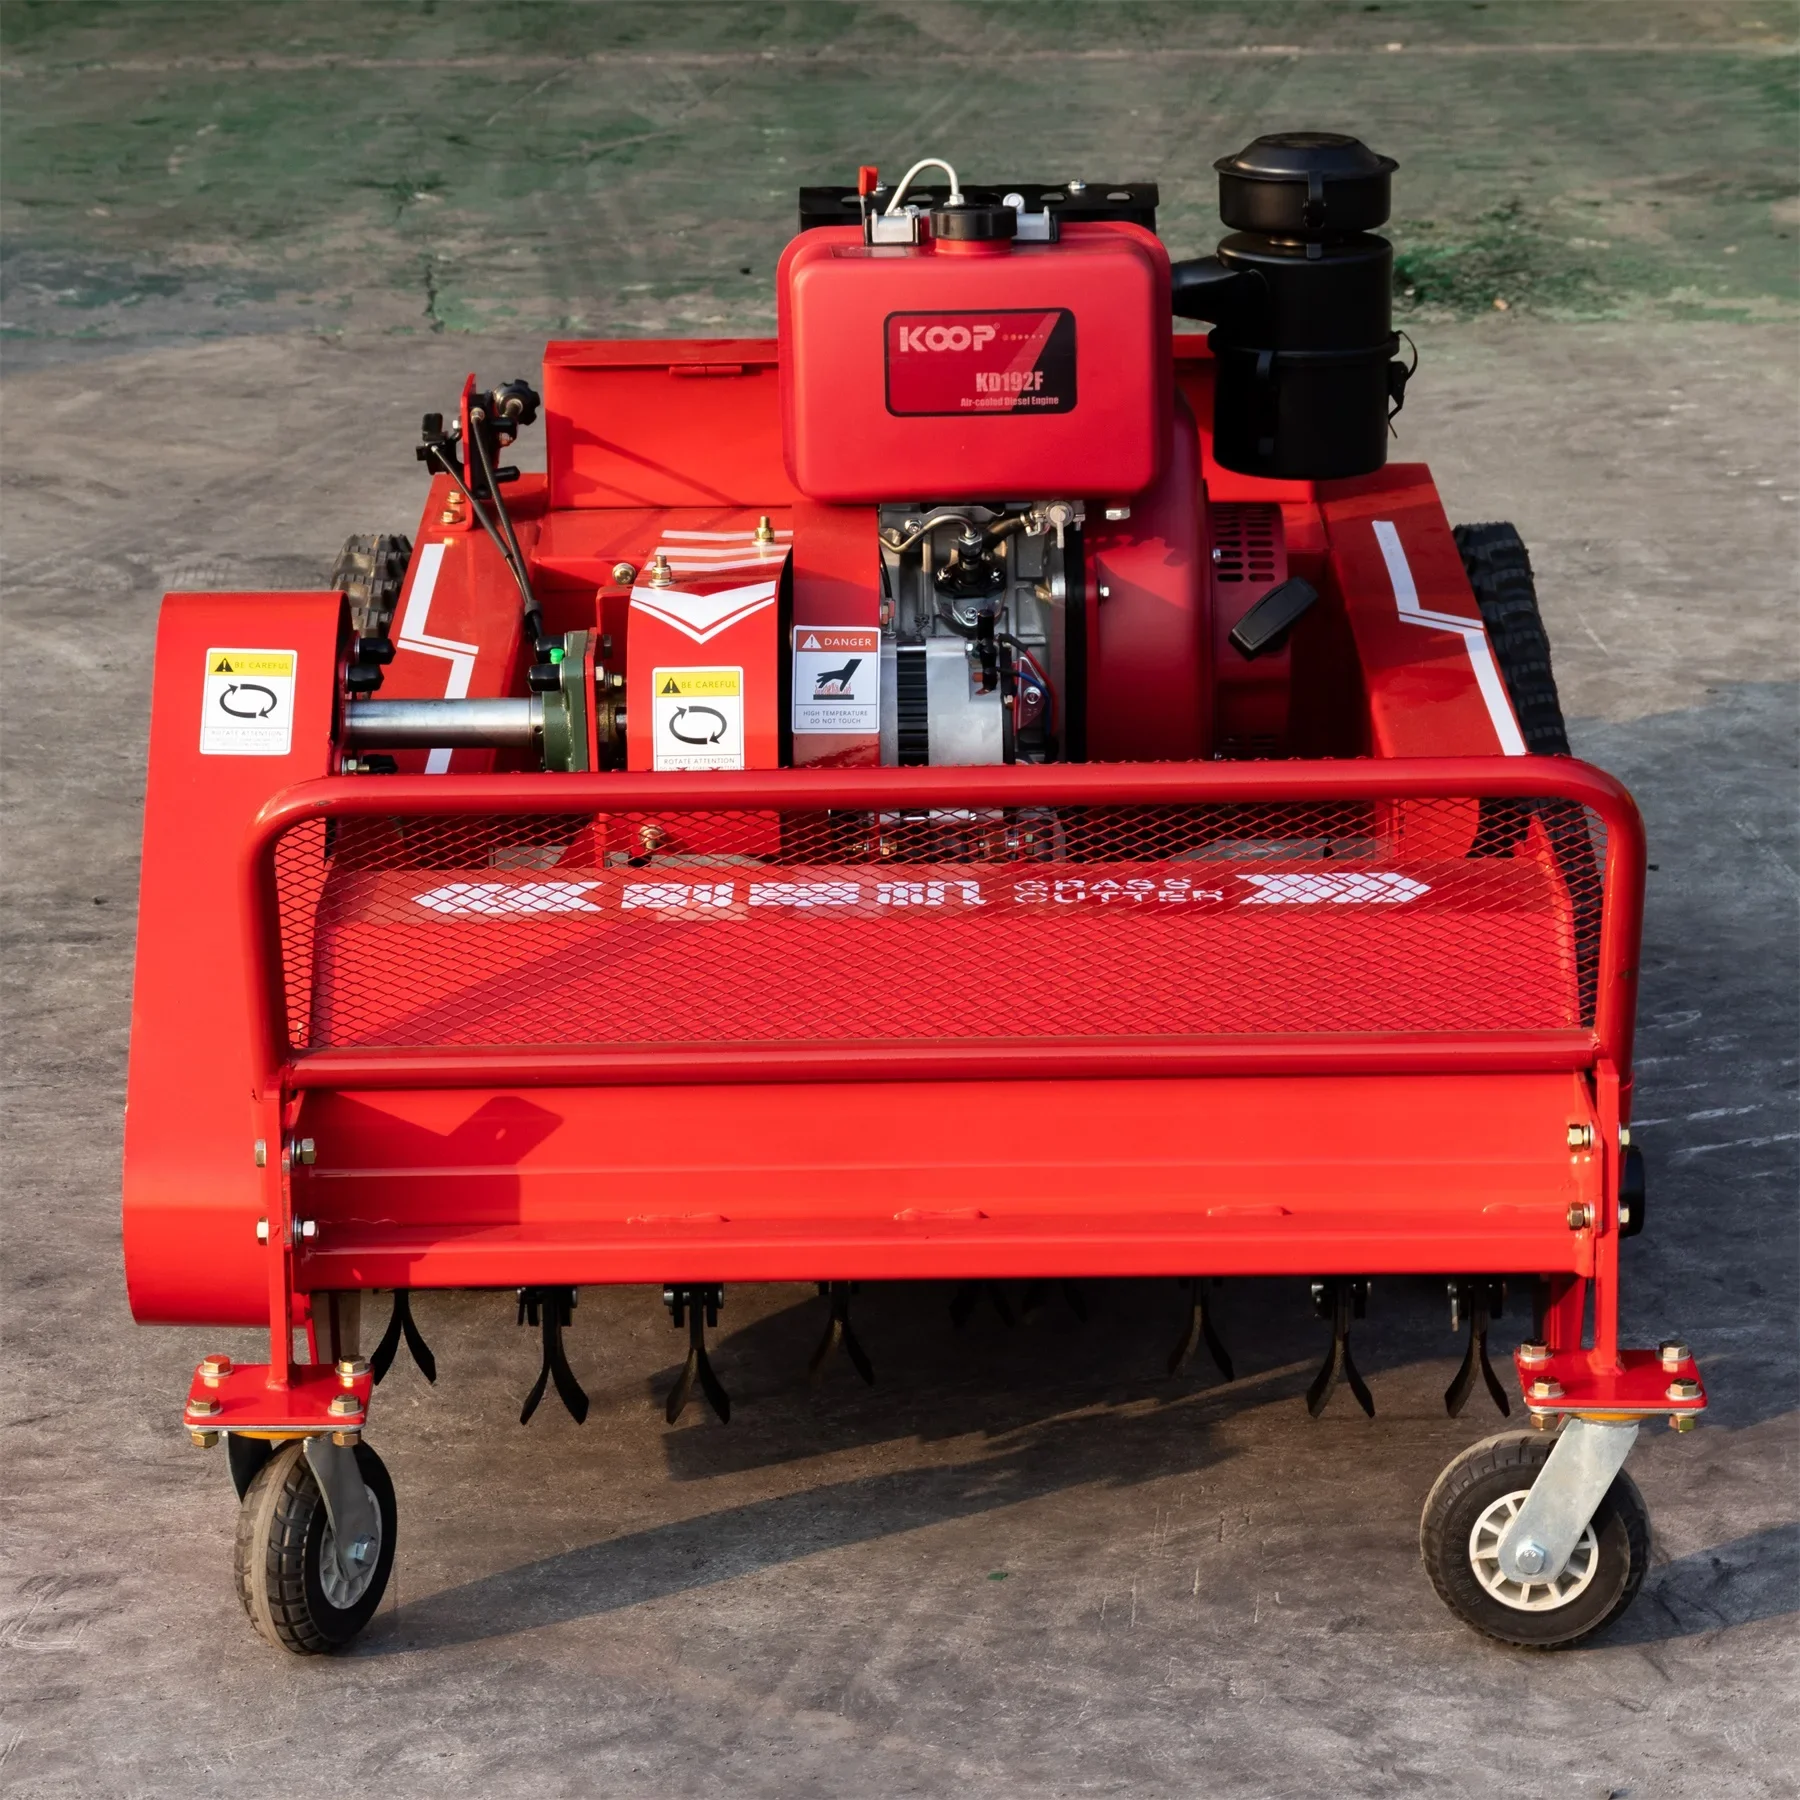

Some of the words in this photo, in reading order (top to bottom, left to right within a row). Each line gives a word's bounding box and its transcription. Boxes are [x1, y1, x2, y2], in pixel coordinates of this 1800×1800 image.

[899, 324, 997, 353] KOOP
[975, 371, 1044, 393] KD192F
[960, 397, 1003, 407] Air-cooled
[1005, 396, 1031, 406] Diesel
[1031, 395, 1059, 407] Engine
[824, 637, 872, 647] DANGER
[234, 661, 245, 669] BE
[248, 661, 289, 670] CAREFUL
[681, 681, 694, 689] BE
[695, 680, 737, 689] CAREFUL
[1013, 878, 1193, 891] GRASS
[1013, 890, 1224, 903] CUTTER
